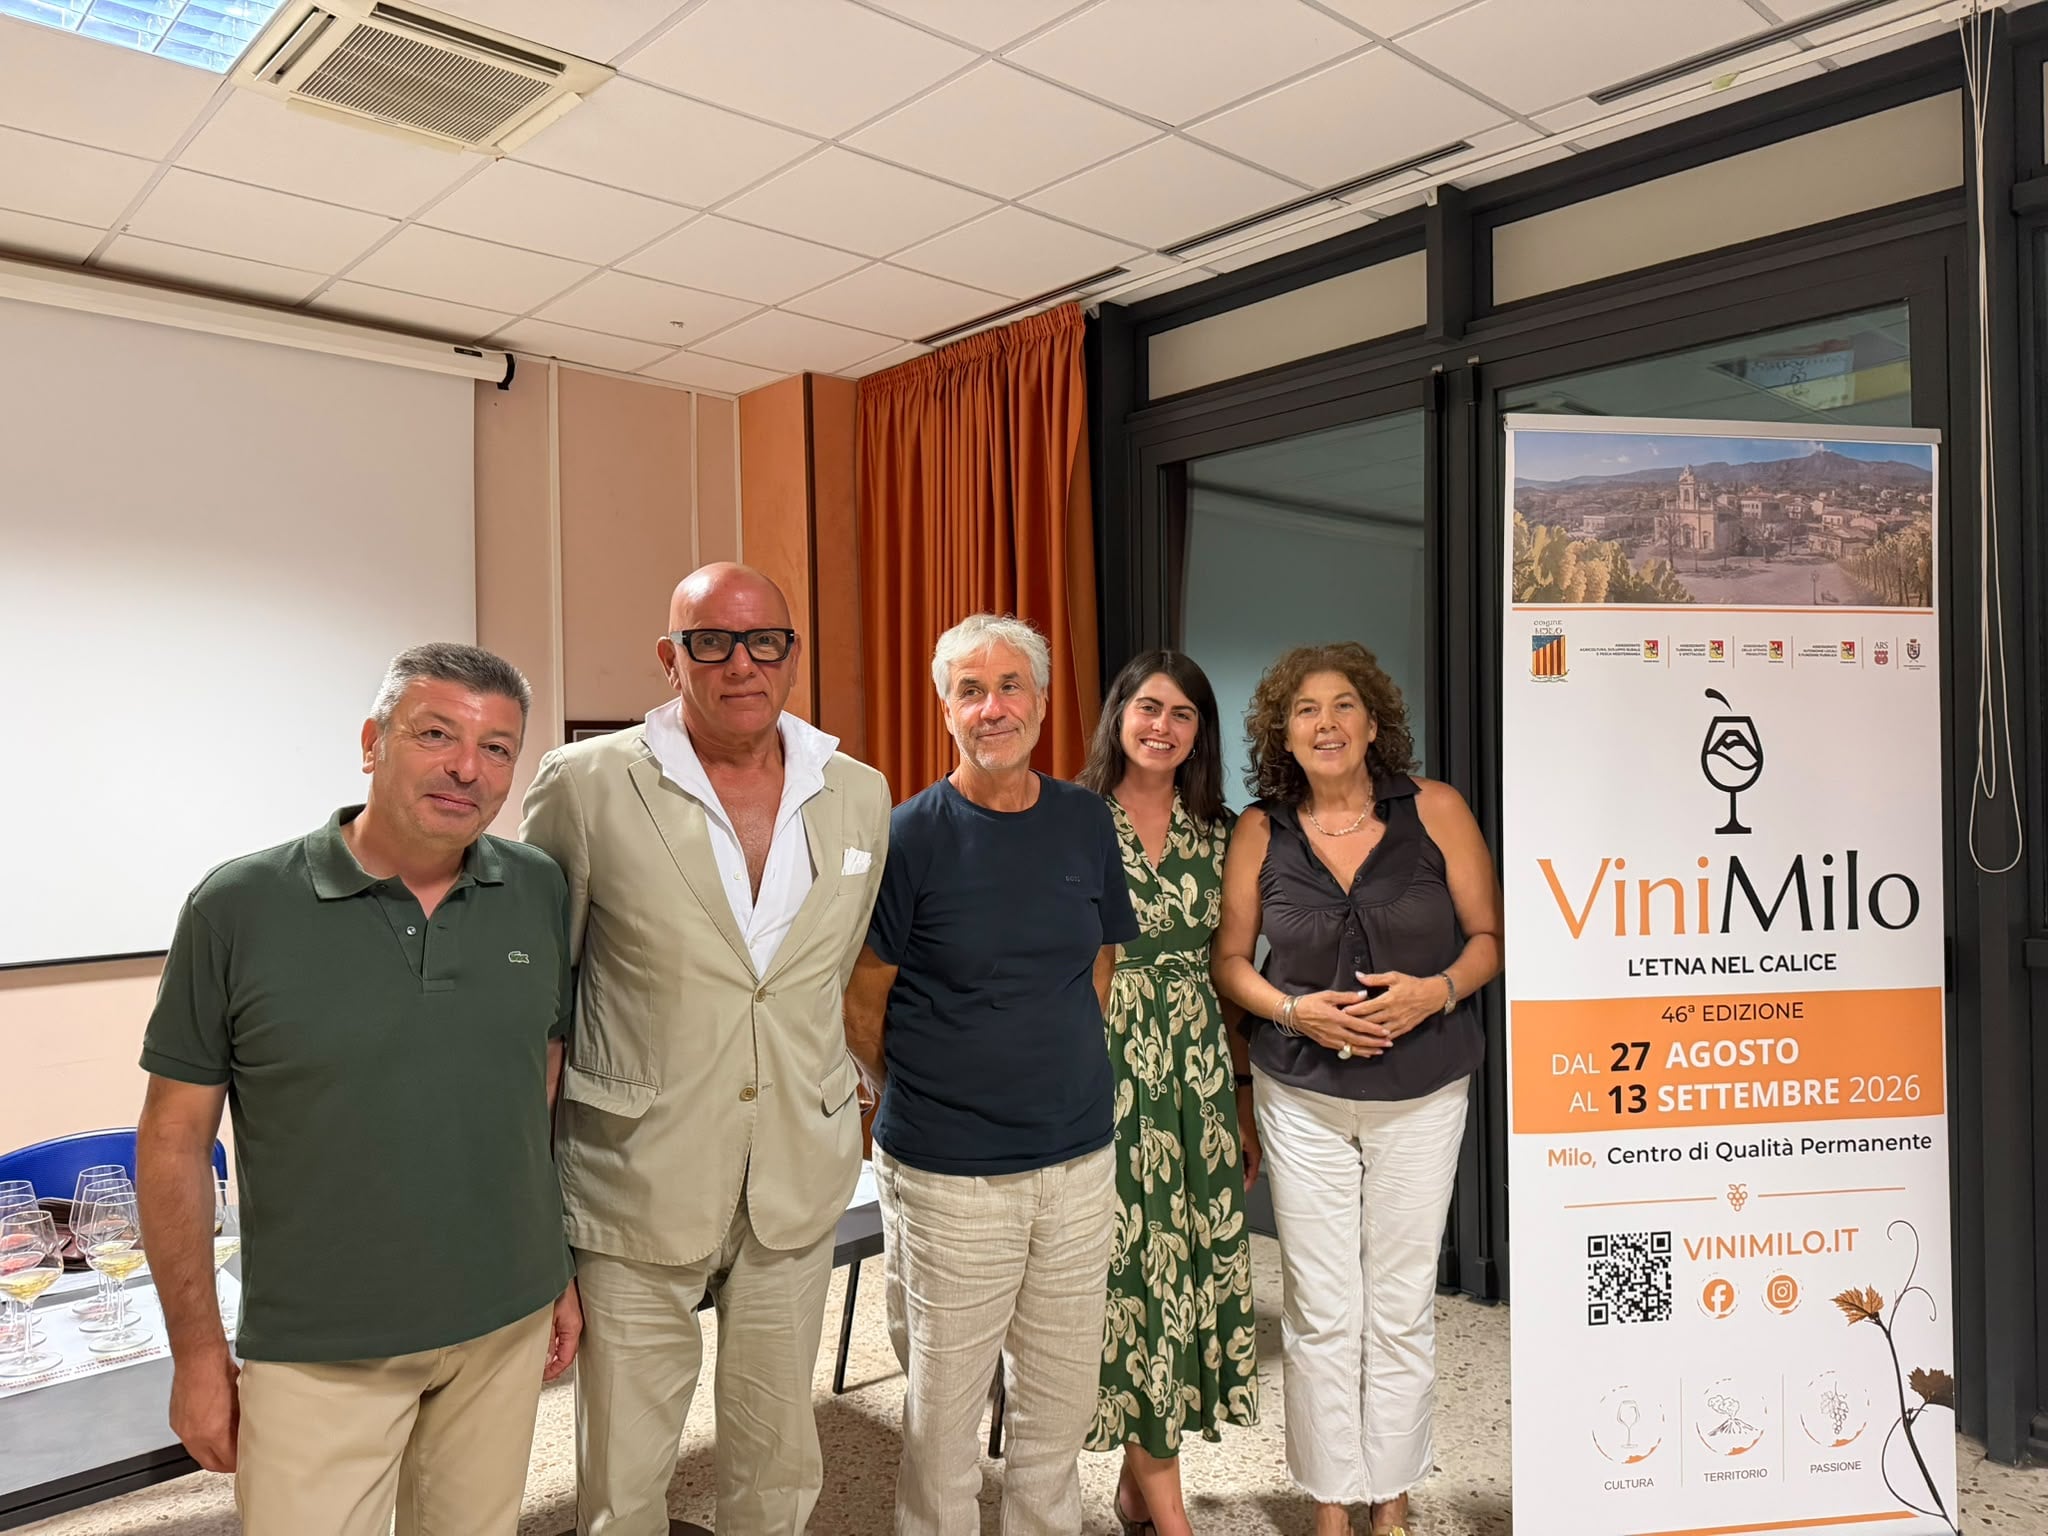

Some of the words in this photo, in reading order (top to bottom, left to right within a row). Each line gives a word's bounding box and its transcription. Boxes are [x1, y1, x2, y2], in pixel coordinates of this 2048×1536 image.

[1536, 849, 1921, 940] ViniMilo
[1711, 956, 1755, 975] NEL
[1759, 953, 1838, 973] CALICE
[1702, 1001, 1804, 1022] EDIZIONE
[1552, 1054, 1600, 1075] DAL
[1610, 1041, 1651, 1073] 27
[1665, 1037, 1799, 1069] AGOSTO
[1569, 1092, 1599, 1113] AL
[1607, 1083, 1648, 1114] 13
[1657, 1078, 1840, 1112] SETTEMBRE
[1849, 1074, 1921, 1103] 2026
[1548, 1147, 1597, 1168] Milo,
[1607, 1145, 1683, 1166] Centro
[1688, 1141, 1709, 1161] di
[1715, 1137, 1794, 1163] Qualità
[1800, 1133, 1933, 1156] Permanente
[1683, 1227, 1860, 1261] VINIMILO.IT
[1703, 1468, 1768, 1483] TERRITORIO
[1810, 1460, 1862, 1475] PASSIONE
[1603, 1477, 1655, 1492] CULTURA
